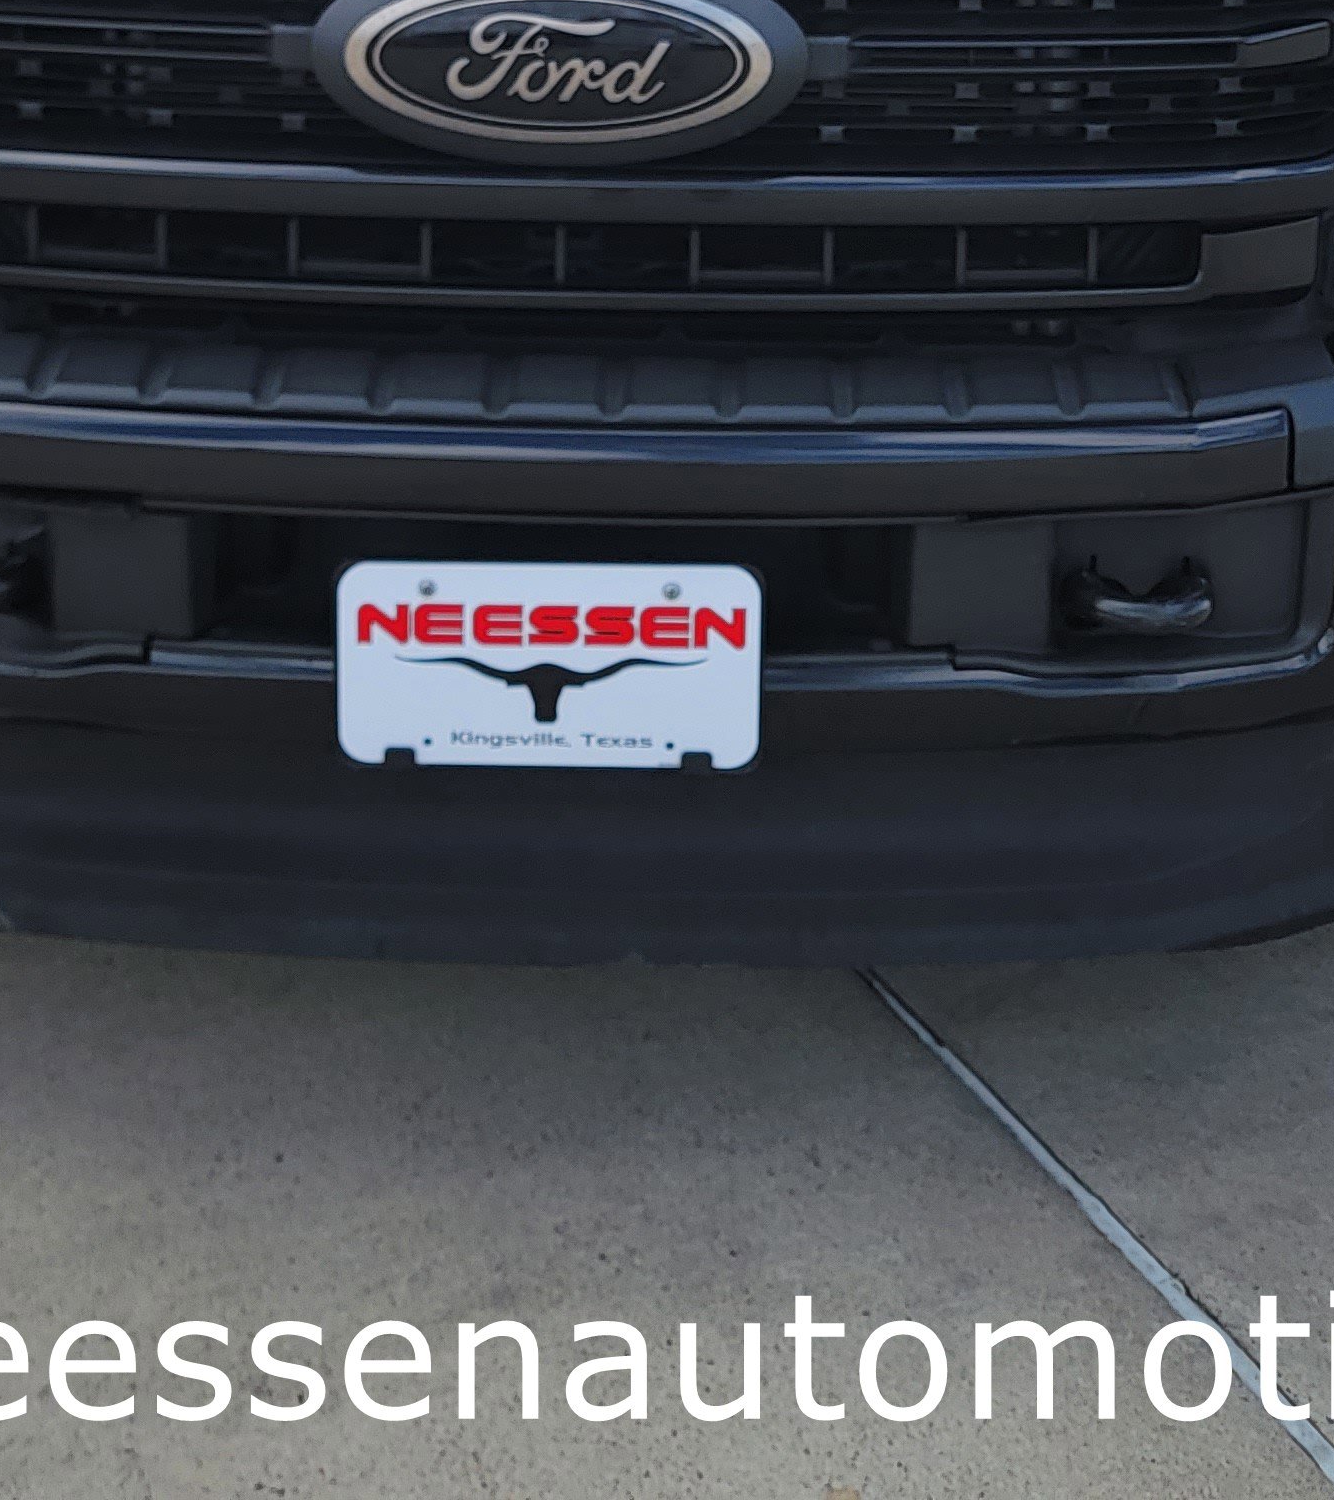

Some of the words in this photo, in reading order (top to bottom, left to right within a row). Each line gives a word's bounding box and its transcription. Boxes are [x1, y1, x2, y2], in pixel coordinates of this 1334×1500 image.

[447, 12, 670, 104] Ford
[356, 603, 746, 650] NEESSEN
[450, 731, 572, 750] Kingsville,
[579, 732, 654, 749] Texas
